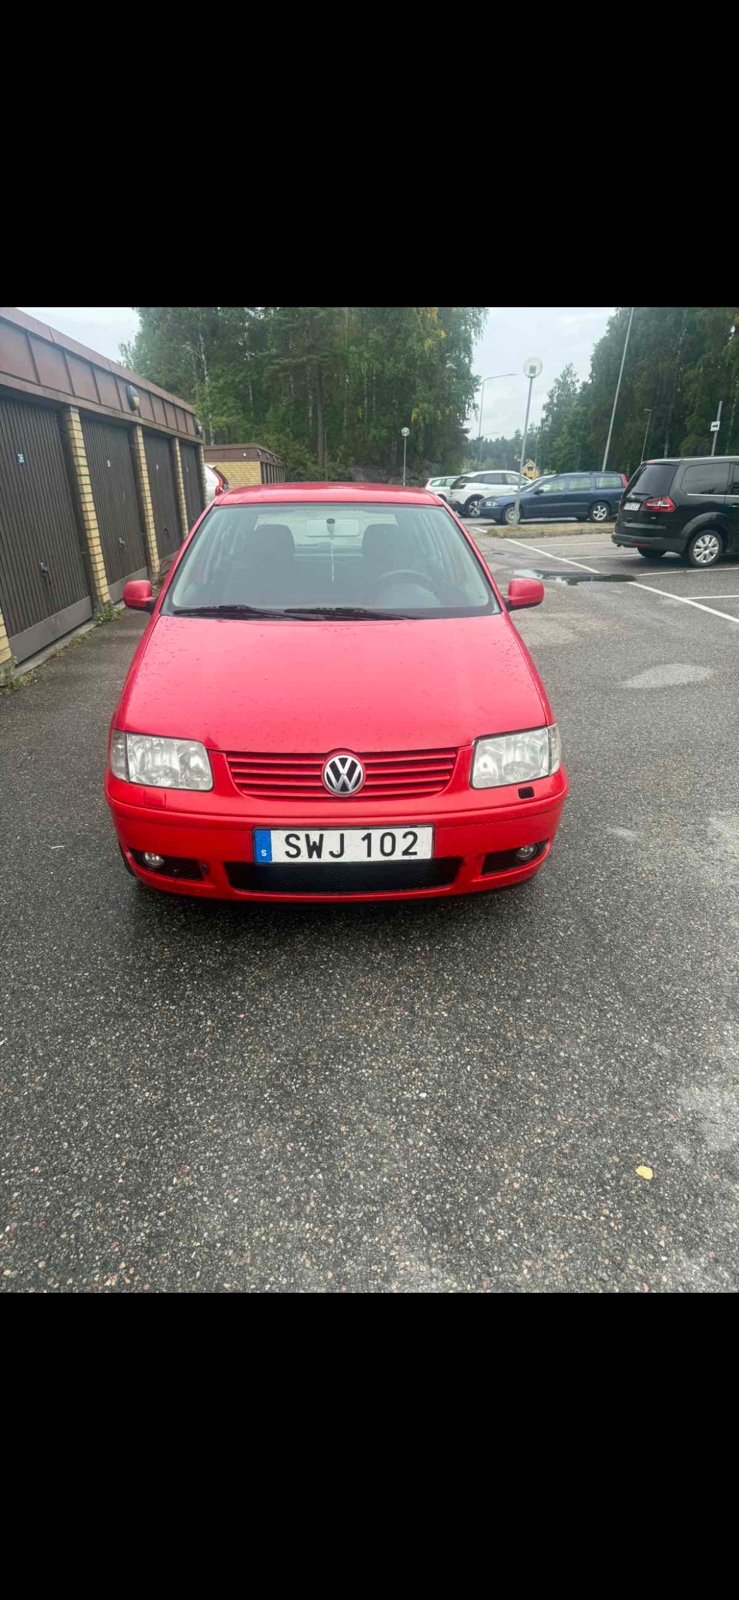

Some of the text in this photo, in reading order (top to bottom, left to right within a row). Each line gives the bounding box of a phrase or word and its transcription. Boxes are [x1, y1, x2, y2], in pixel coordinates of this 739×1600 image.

[324, 755, 364, 795] VW
[261, 849, 267, 857] S
[284, 831, 419, 859] SWJ 102
